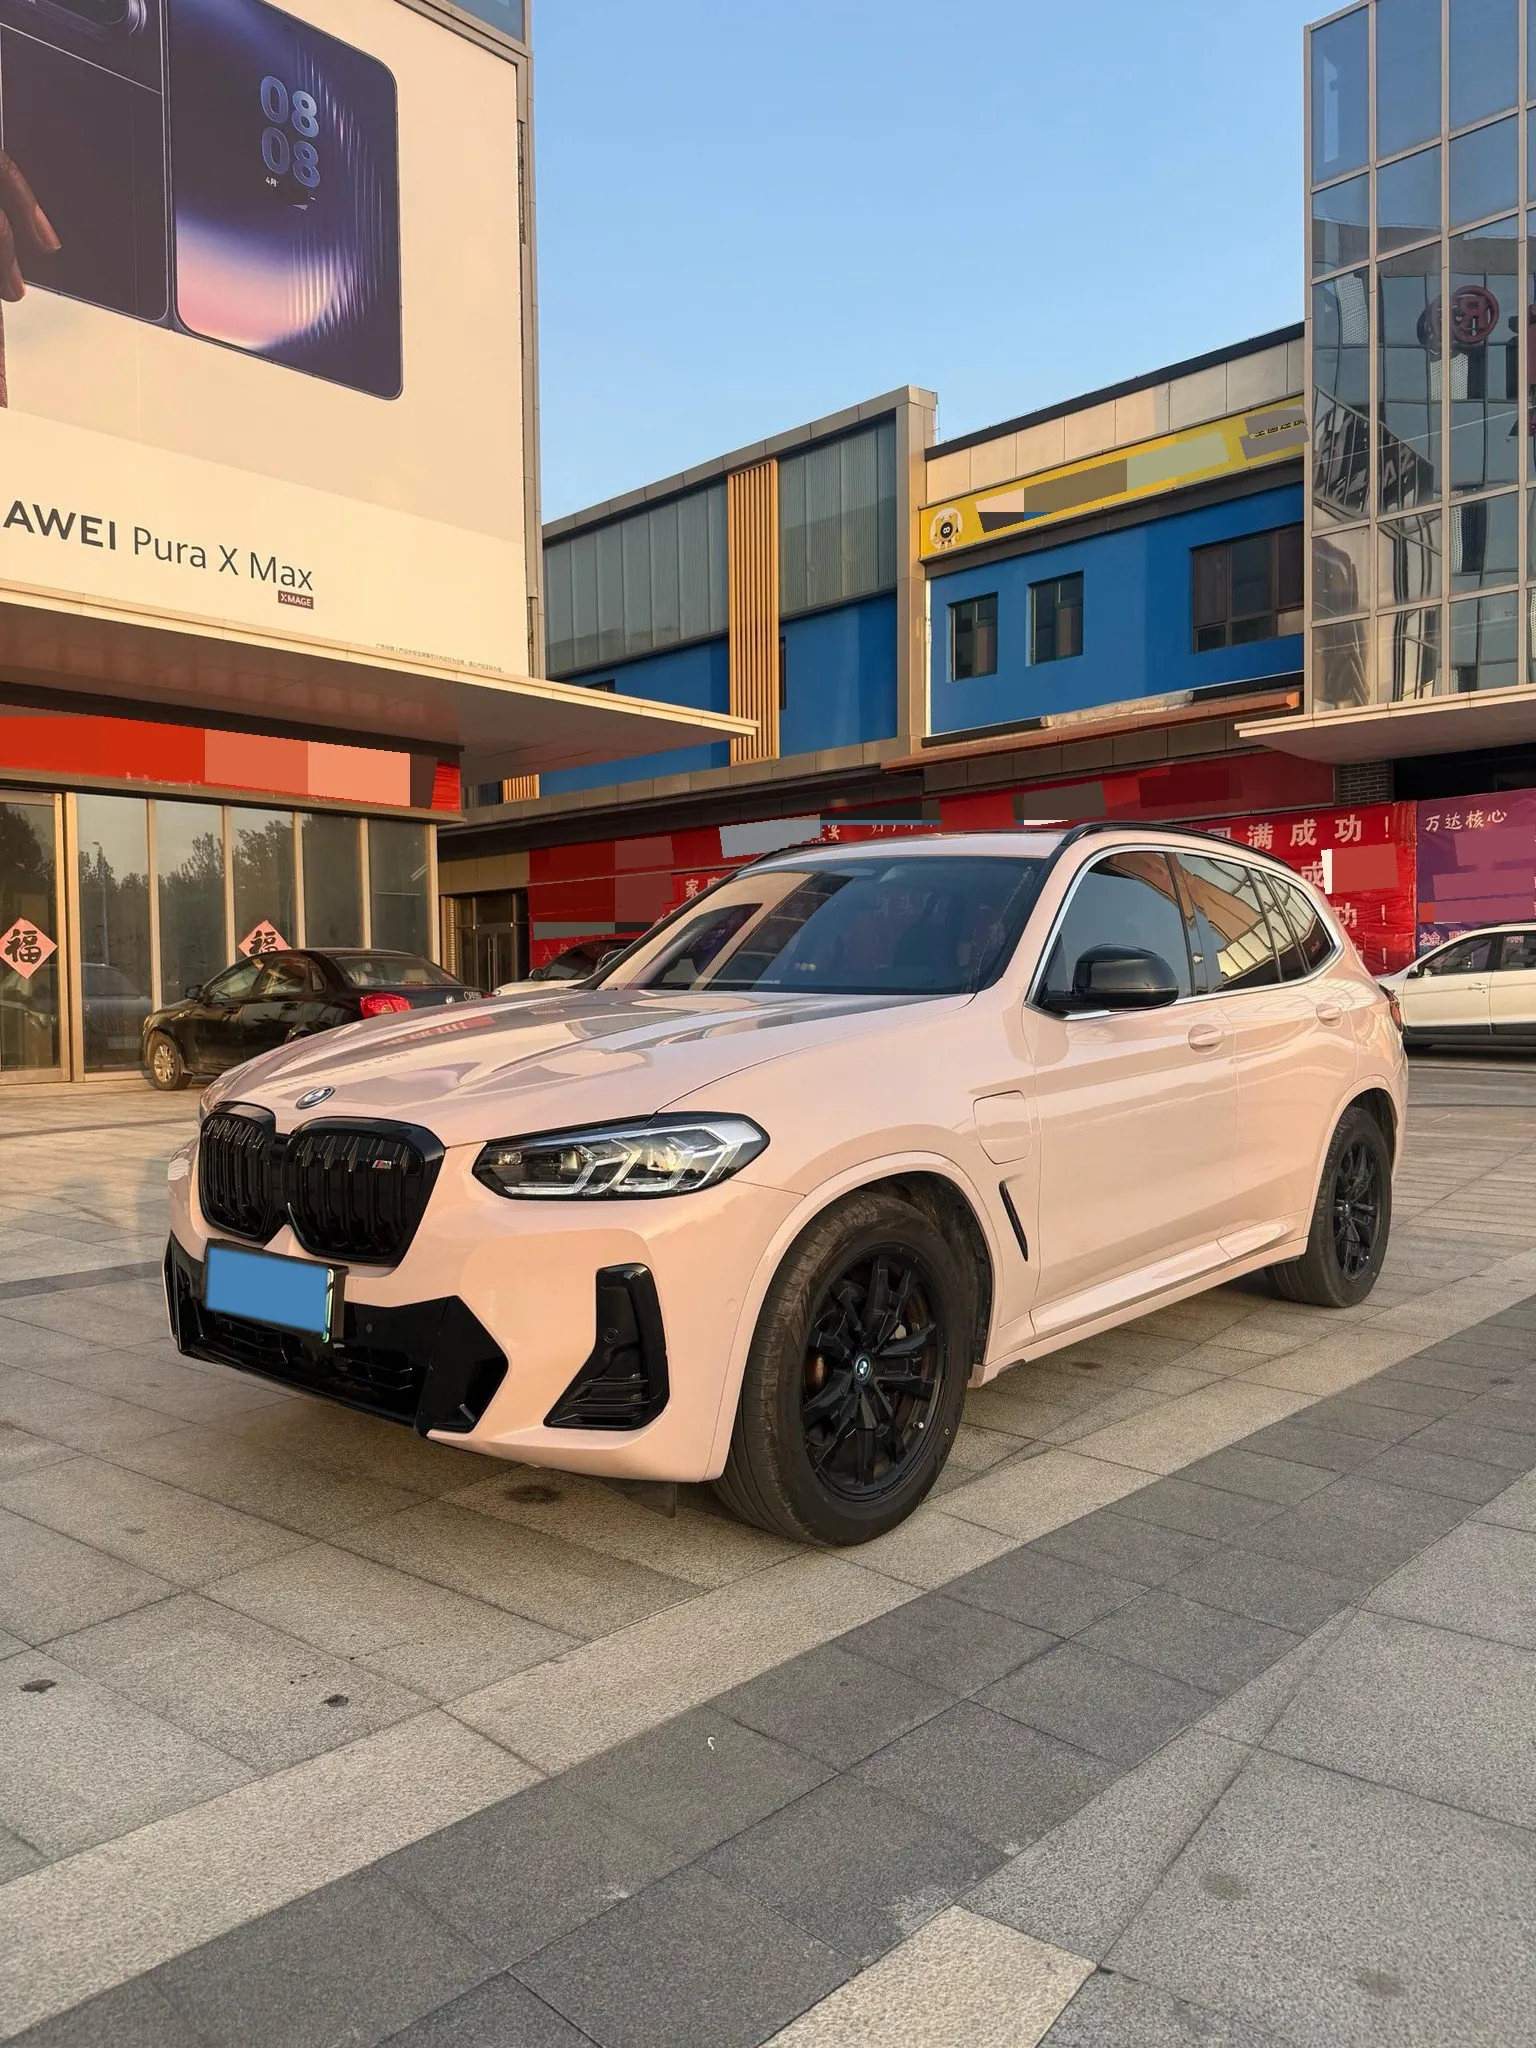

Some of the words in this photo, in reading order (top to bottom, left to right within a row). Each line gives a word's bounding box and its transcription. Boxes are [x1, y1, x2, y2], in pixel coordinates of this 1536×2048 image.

[260, 75, 319, 138] 08
[261, 126, 321, 188] 08
[2, 499, 116, 550] AWEI
[134, 526, 207, 569] Pura
[218, 545, 239, 575] X
[250, 551, 314, 591] Max
[279, 592, 313, 608] XMAGE
[1425, 809, 1508, 833] 万达核心
[5, 928, 42, 964] 福
